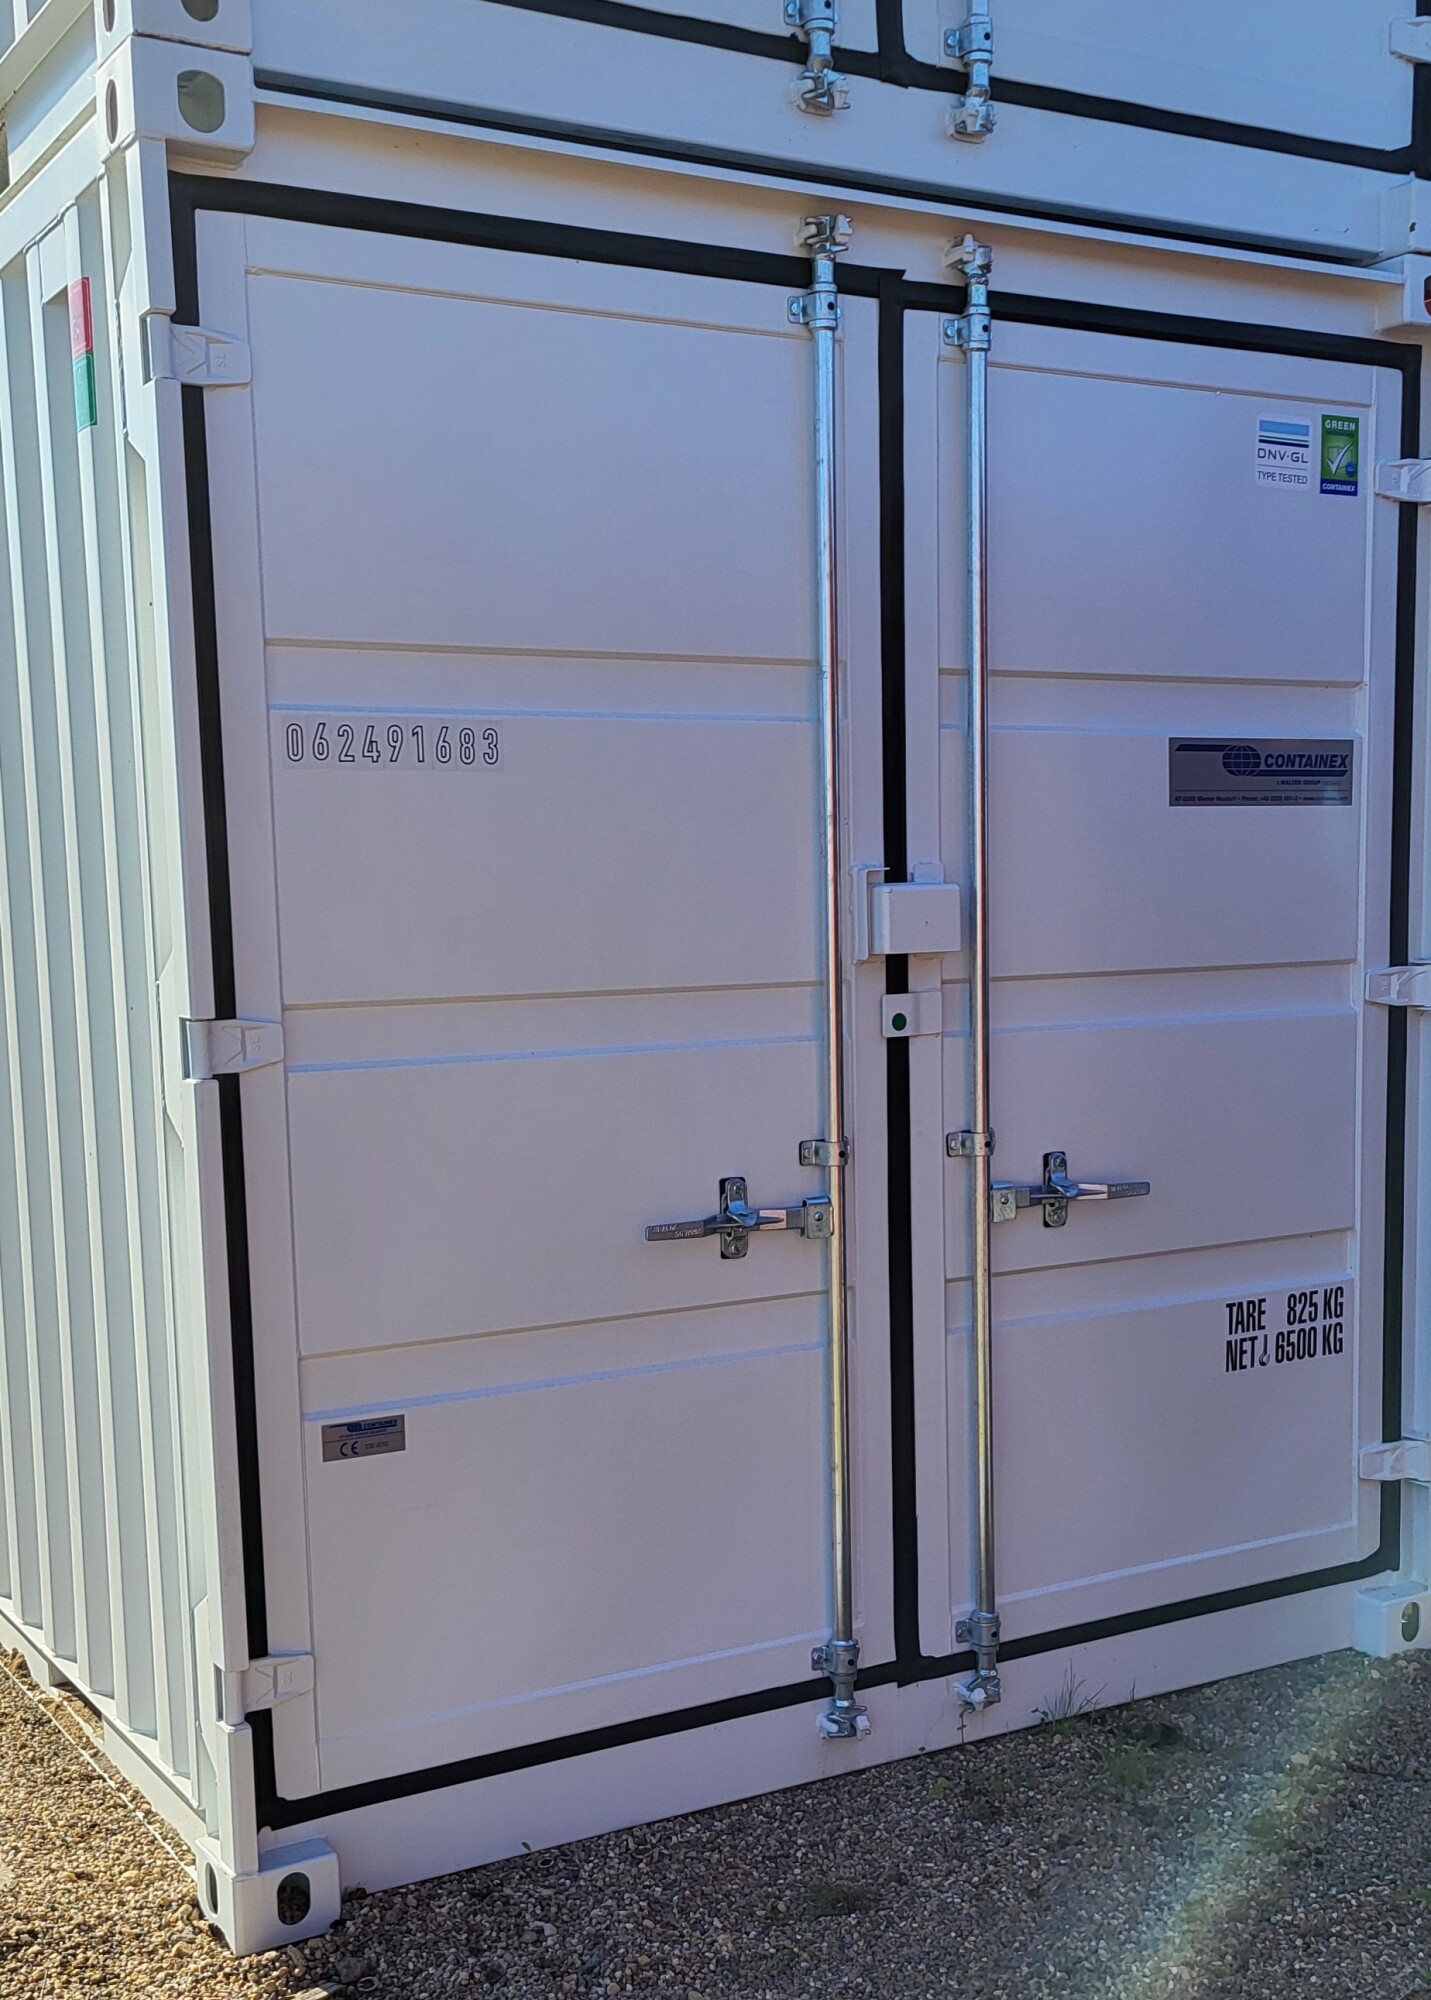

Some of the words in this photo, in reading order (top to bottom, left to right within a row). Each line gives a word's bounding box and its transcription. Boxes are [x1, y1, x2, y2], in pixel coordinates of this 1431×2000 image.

[1325, 420, 1355, 431] GREEN
[1257, 471, 1276, 481] TYPE
[1278, 473, 1307, 485] TESTED
[286, 722, 499, 765] 062491683
[1264, 753, 1349, 769] CONTAINEX
[1225, 1298, 1266, 1335] TARE
[1286, 1290, 1318, 1326] 825
[1323, 1286, 1344, 1320] KG
[1225, 1335, 1258, 1373] NET
[1275, 1326, 1317, 1364] 6500
[1322, 1322, 1343, 1356] KG
